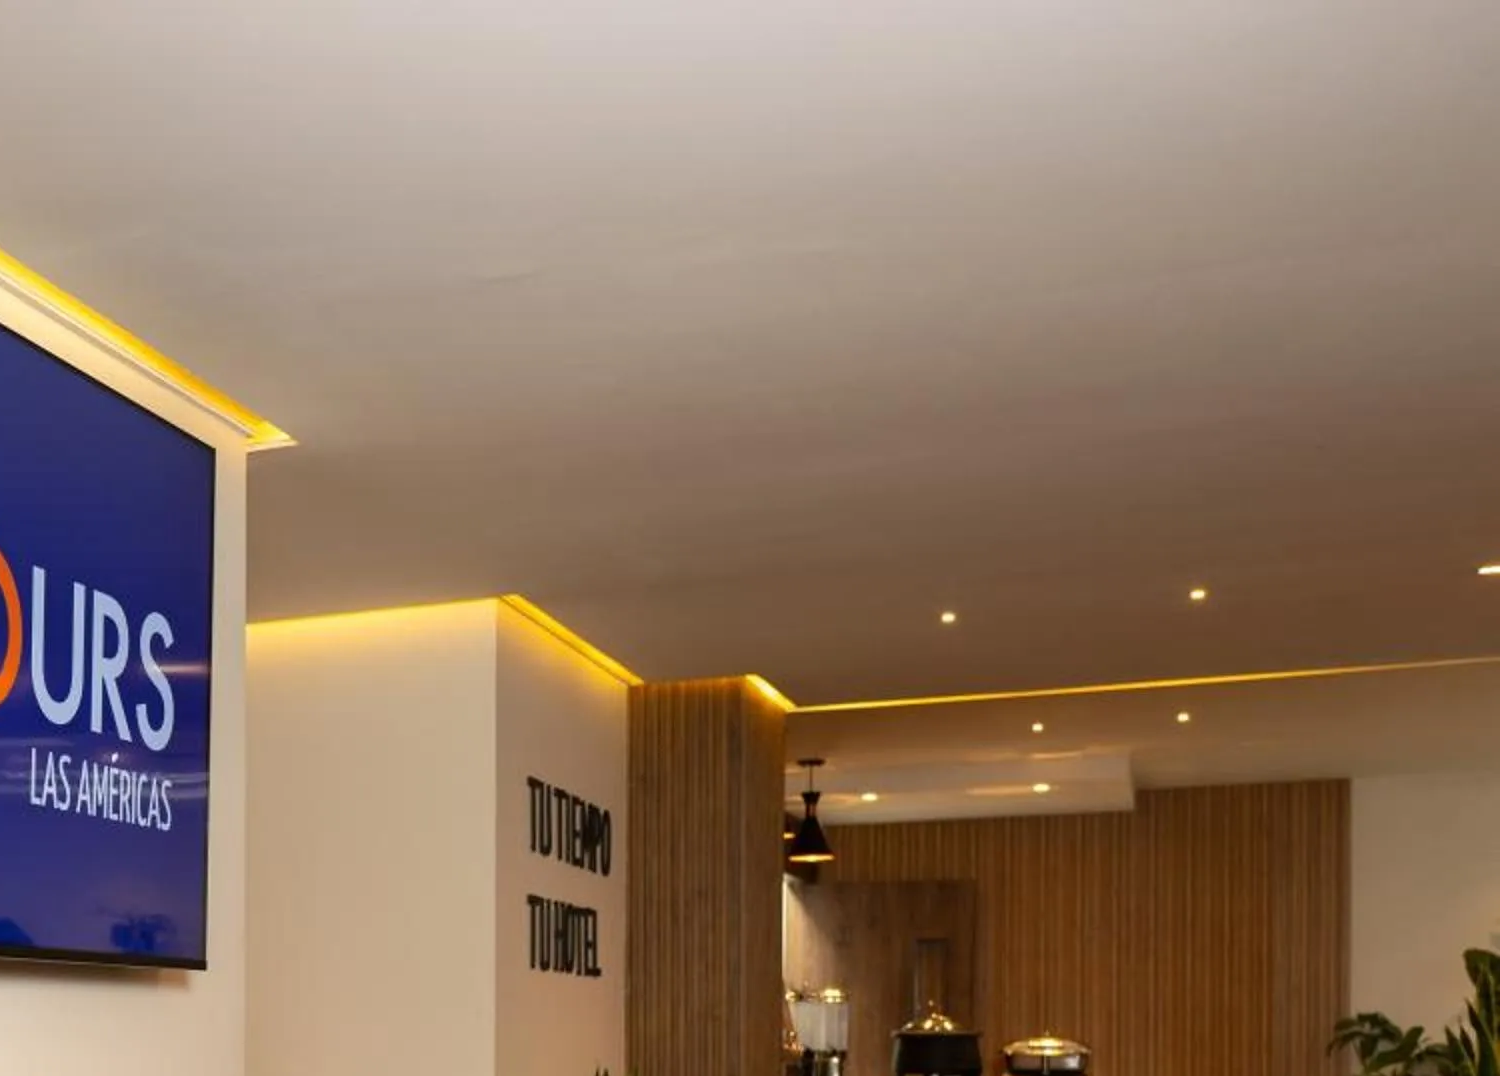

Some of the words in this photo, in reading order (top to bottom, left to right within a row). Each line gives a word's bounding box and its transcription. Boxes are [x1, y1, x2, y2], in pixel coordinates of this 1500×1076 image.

[29, 747, 72, 811] LAS
[75, 752, 172, 832] AMÉRICAS
[526, 775, 552, 857] TU
[526, 894, 551, 972] TU
[552, 900, 602, 978] HOTEL
